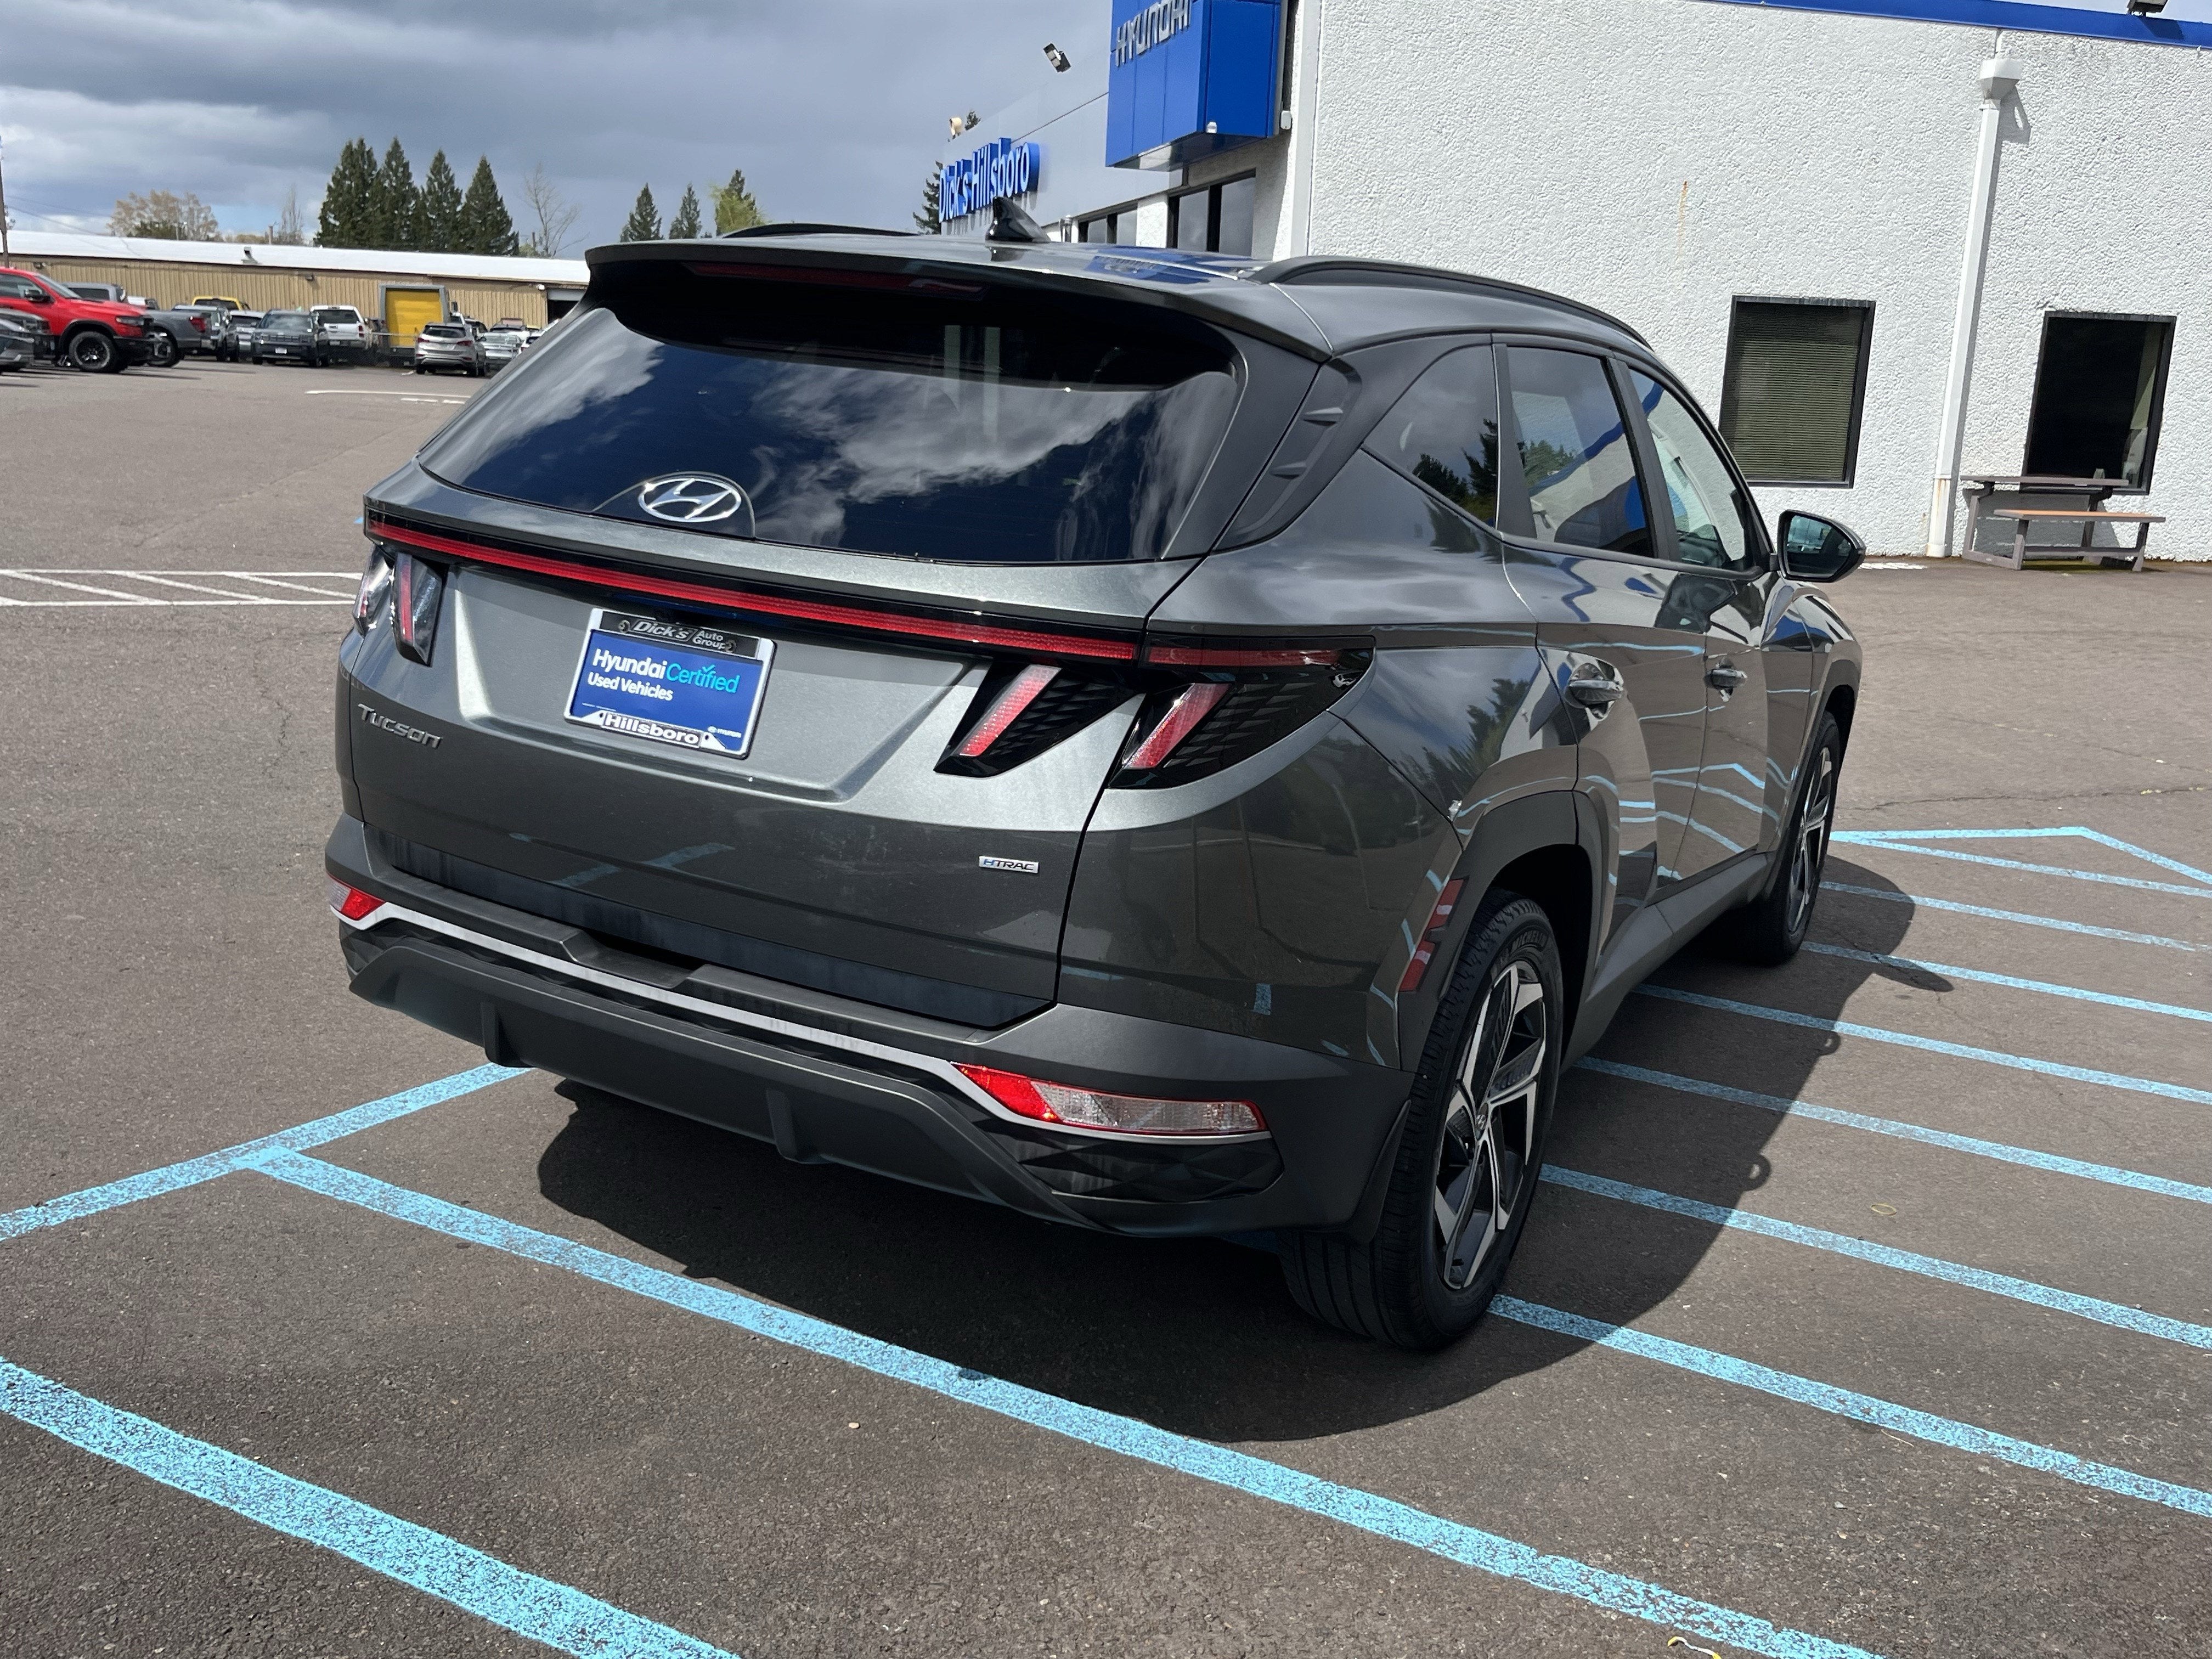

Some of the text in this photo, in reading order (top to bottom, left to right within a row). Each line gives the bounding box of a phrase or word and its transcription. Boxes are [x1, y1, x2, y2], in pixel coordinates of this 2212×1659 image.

[1115, 0, 1192, 66] HYUNDAI
[939, 138, 1032, 223] Dick's Hillsboro
[634, 619, 690, 639] Dick's
[697, 629, 724, 641] Auto
[592, 648, 741, 694] Hyundai Certified
[588, 672, 674, 701] Used Vehicles
[605, 713, 699, 745] Hillsboro
[983, 859, 1034, 871] HTRAC
